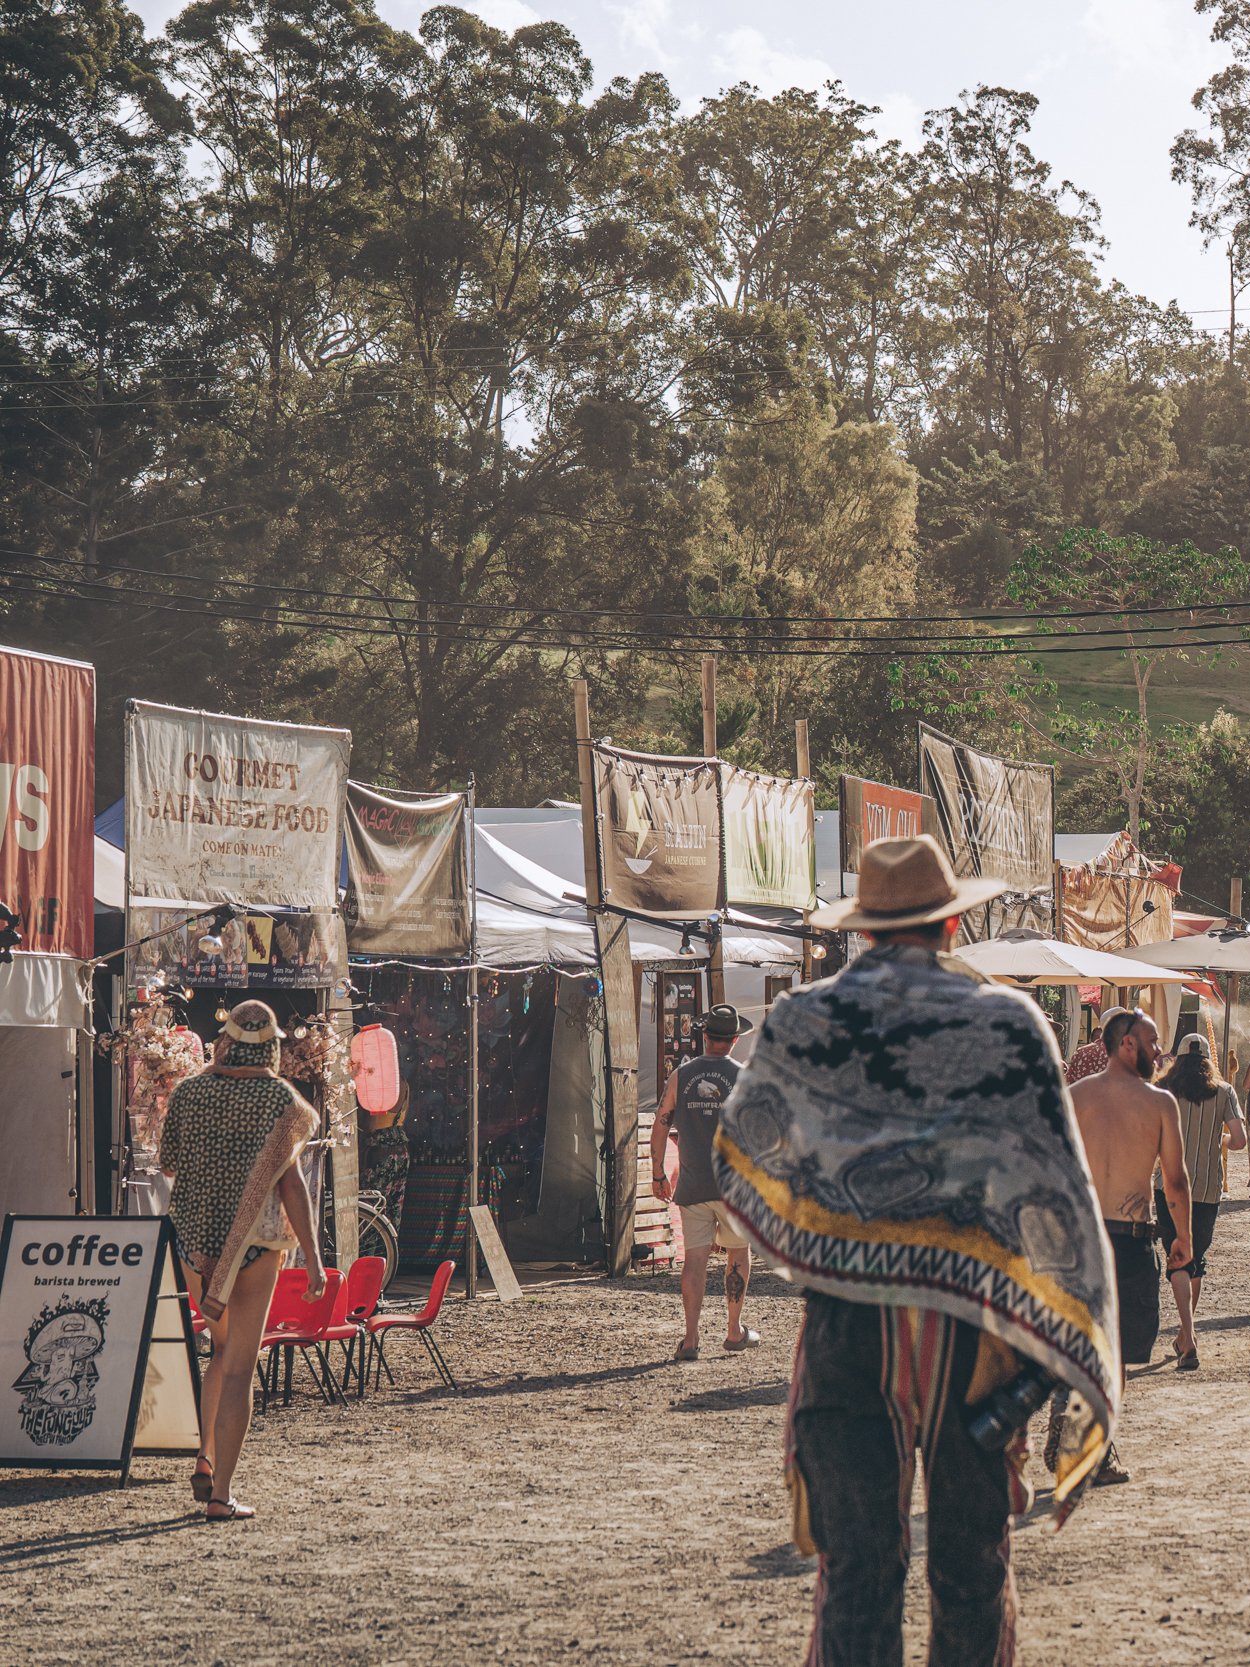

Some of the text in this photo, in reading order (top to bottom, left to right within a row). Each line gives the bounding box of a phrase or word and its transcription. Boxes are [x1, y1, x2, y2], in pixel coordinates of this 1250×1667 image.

[184, 752, 300, 791] GOURMET
[147, 789, 329, 834] JAPANESE FOOD
[866, 802, 918, 842] YUM CHA
[202, 840, 232, 855] COME
[234, 842, 249, 856] ON
[664, 822, 706, 849] RAIJIN
[664, 855, 688, 865] JAPANESE
[21, 1234, 143, 1266] coffee
[34, 1276, 121, 1287] barista brewed
[18, 1405, 43, 1435] THE
